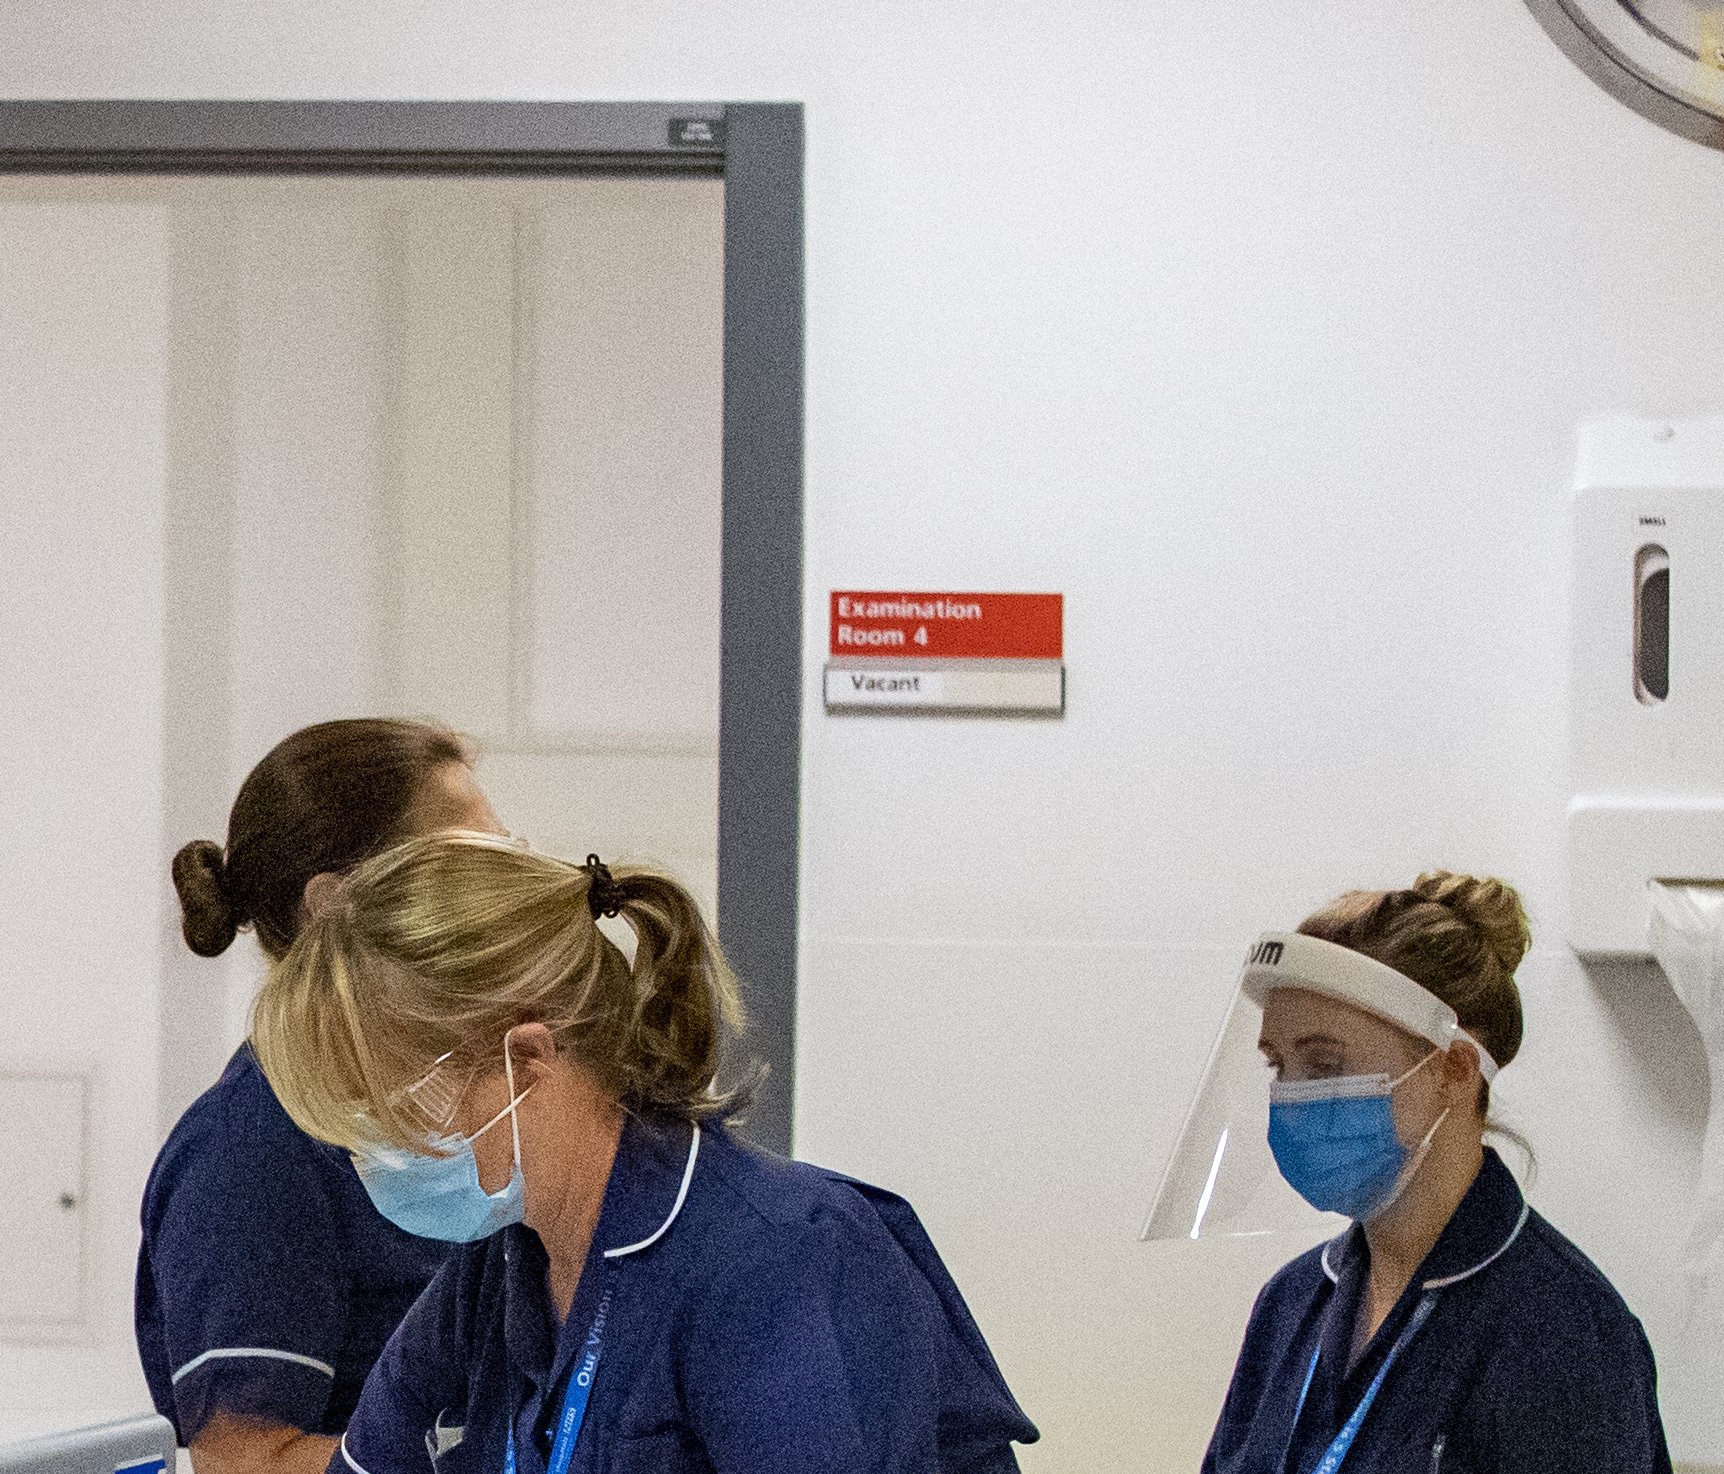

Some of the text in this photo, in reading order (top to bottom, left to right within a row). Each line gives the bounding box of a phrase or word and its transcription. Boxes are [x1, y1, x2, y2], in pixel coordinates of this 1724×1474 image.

[838, 597, 982, 619] Examination
[838, 624, 929, 646] Room 4
[851, 675, 920, 692] Vacant
[586, 1290, 614, 1345] Vision
[577, 1351, 597, 1387] Our
